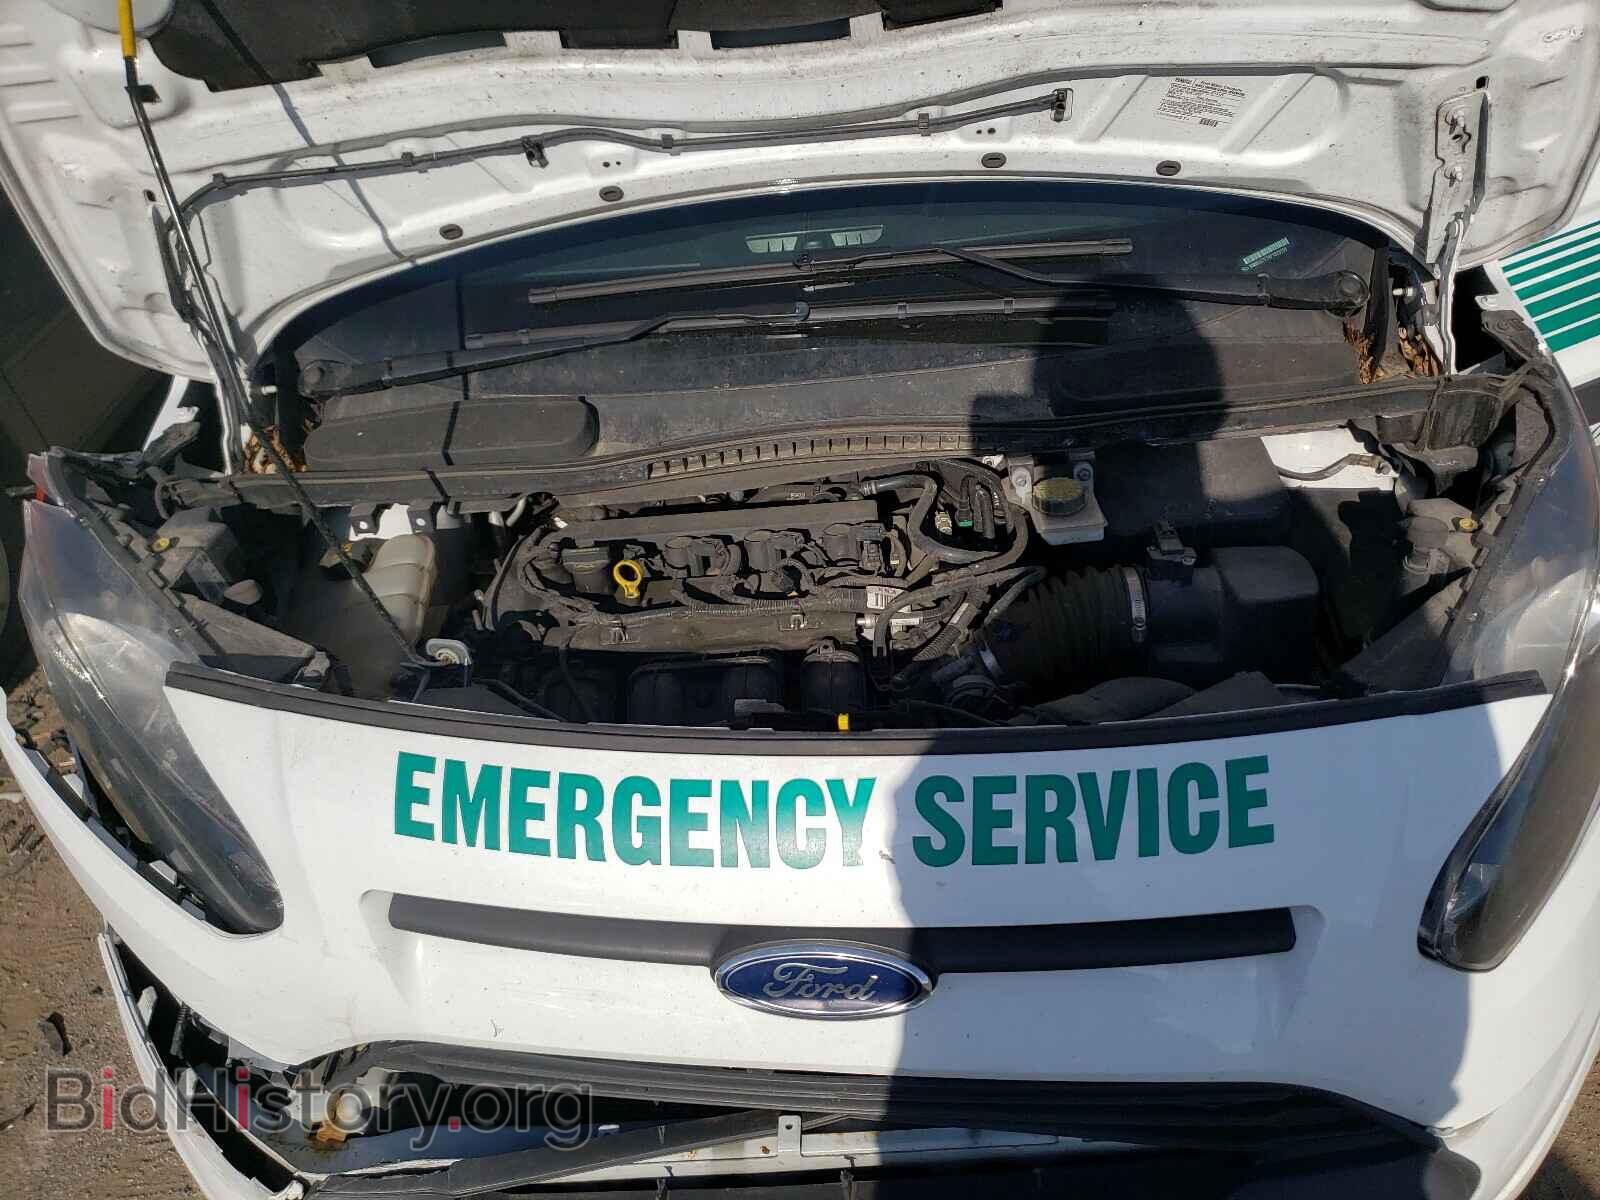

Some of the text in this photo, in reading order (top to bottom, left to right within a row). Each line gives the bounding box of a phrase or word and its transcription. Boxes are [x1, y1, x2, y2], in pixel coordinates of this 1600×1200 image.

[395, 751, 1274, 869] EMERGENCY SERVICE
[763, 962, 879, 1001] Ford
